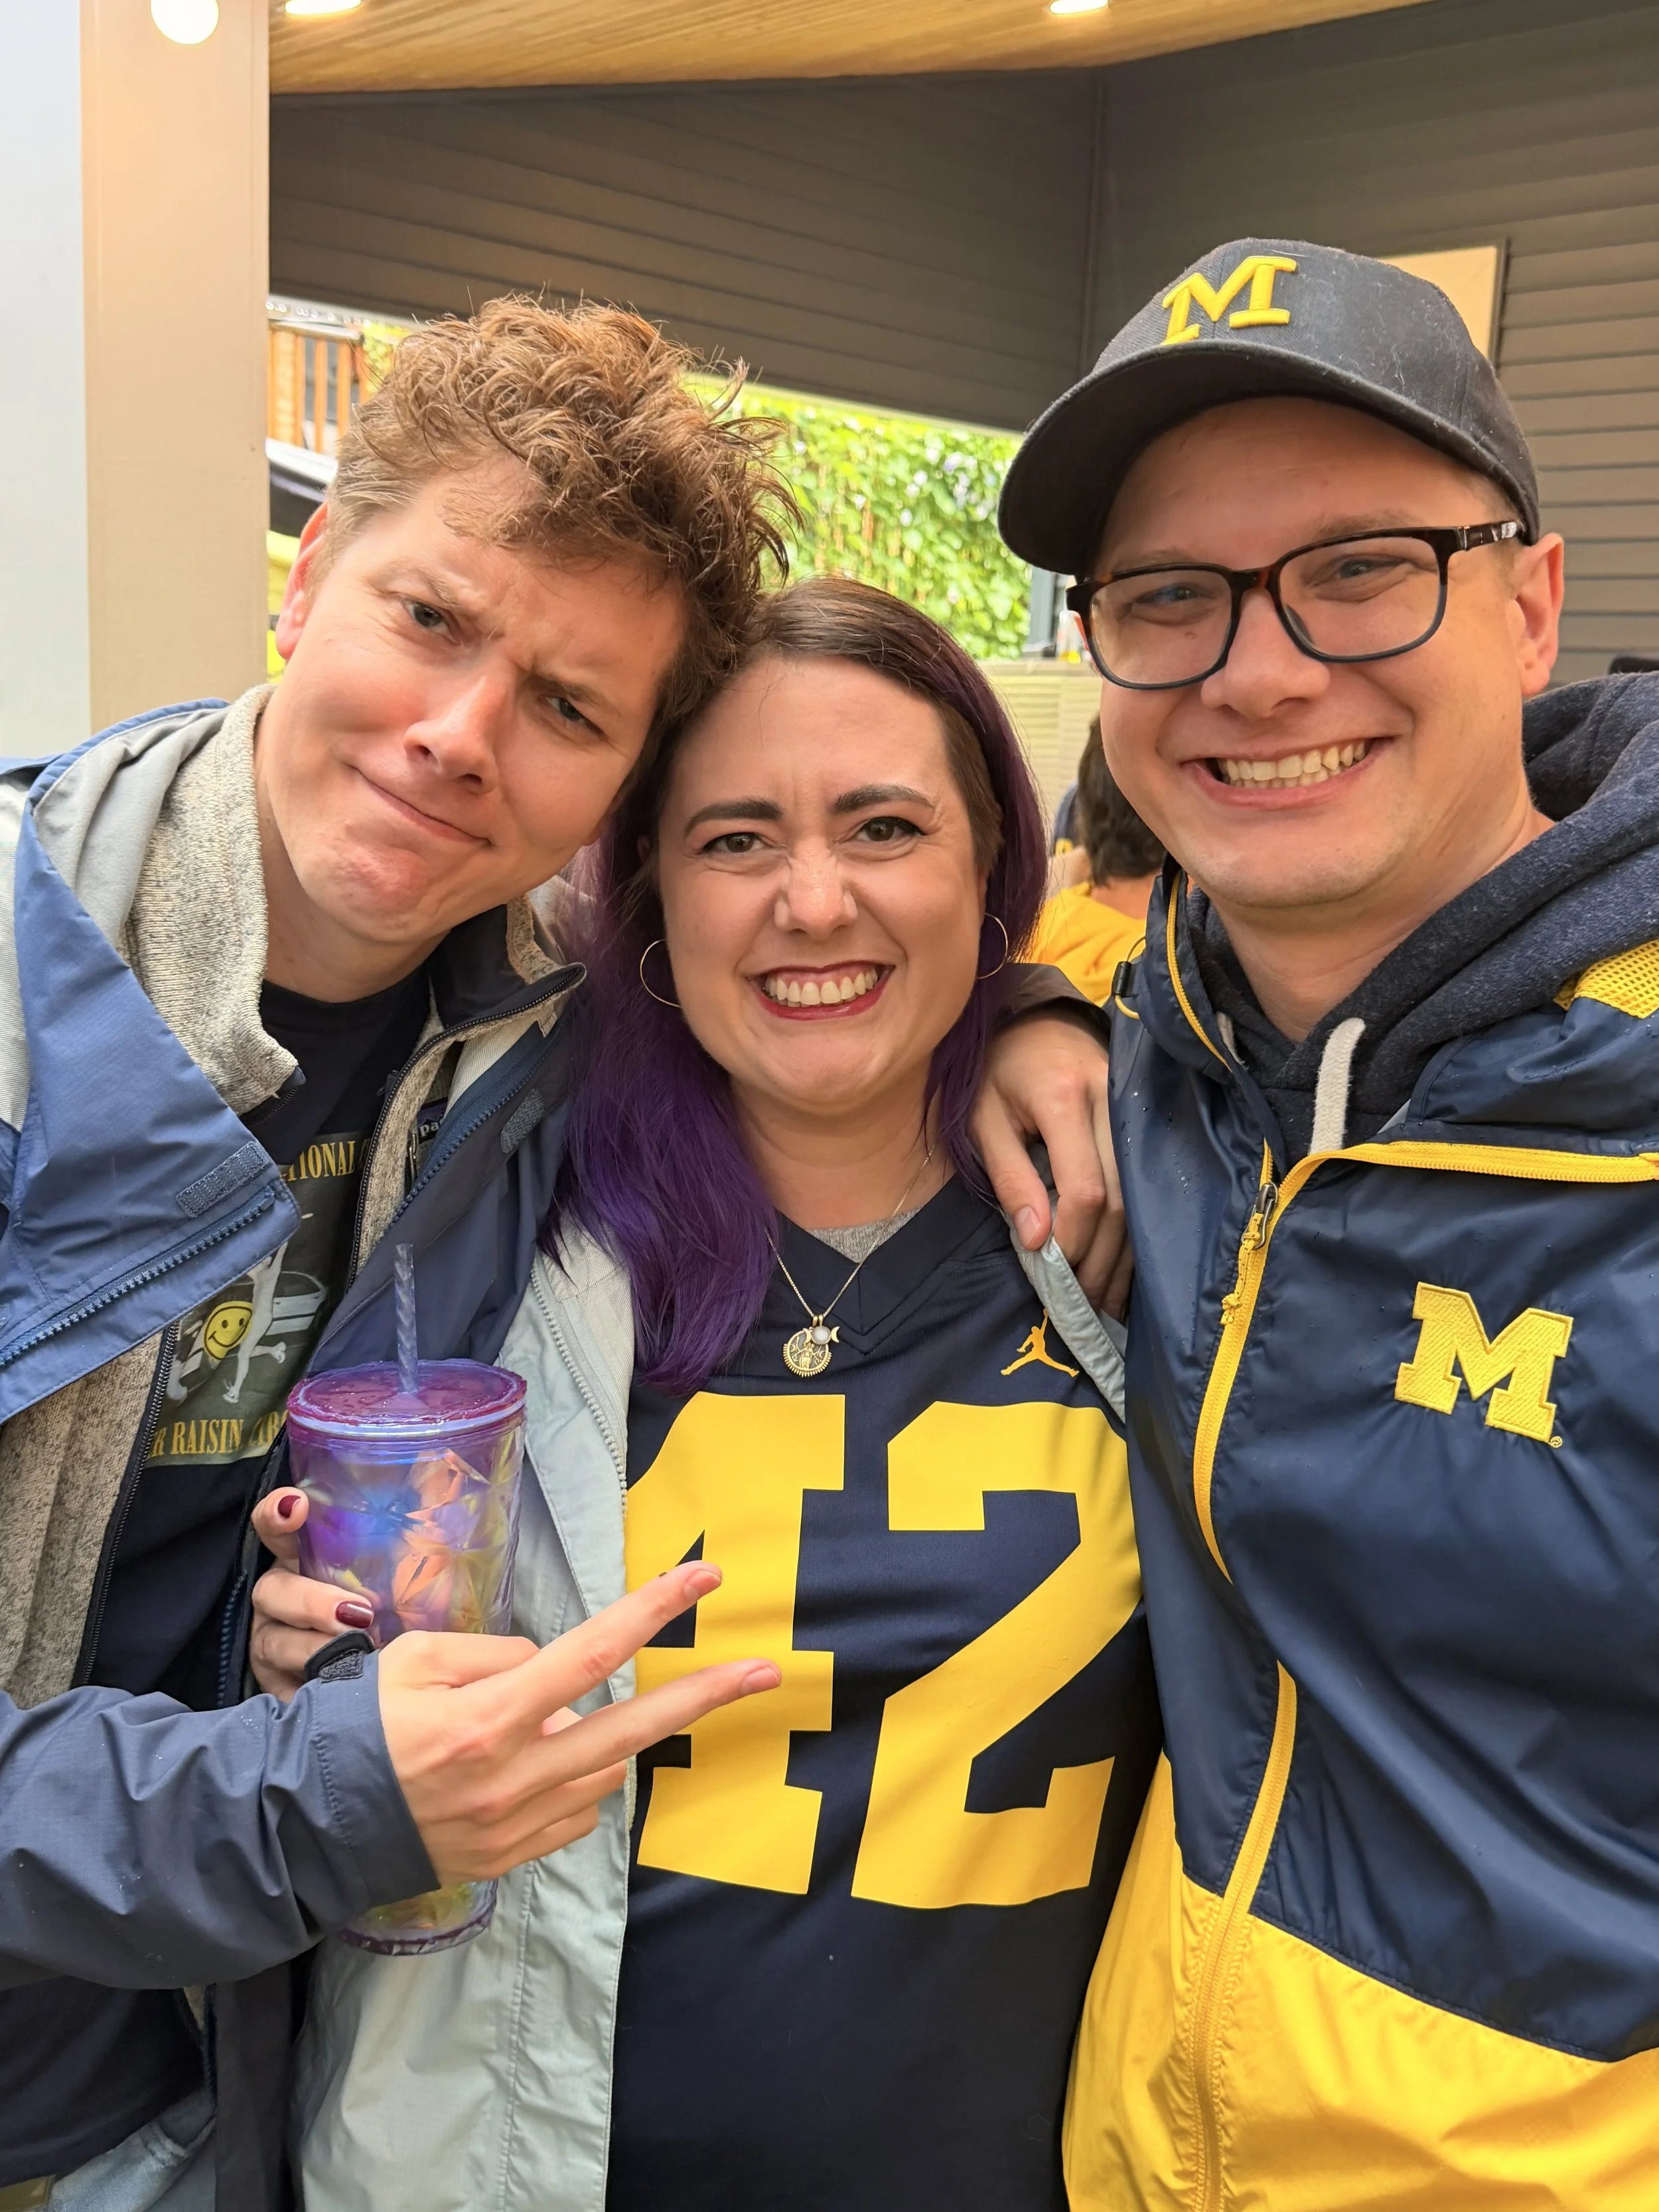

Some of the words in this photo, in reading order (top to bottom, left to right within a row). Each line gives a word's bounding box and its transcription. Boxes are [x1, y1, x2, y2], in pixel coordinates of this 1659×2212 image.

[1163, 256, 1297, 345] M
[281, 1140, 356, 1181] IONAL
[419, 1122, 441, 1137] pa
[1394, 1282, 1573, 1443] M
[170, 1419, 245, 1455] RAISIN
[625, 1391, 1143, 1909] 42
